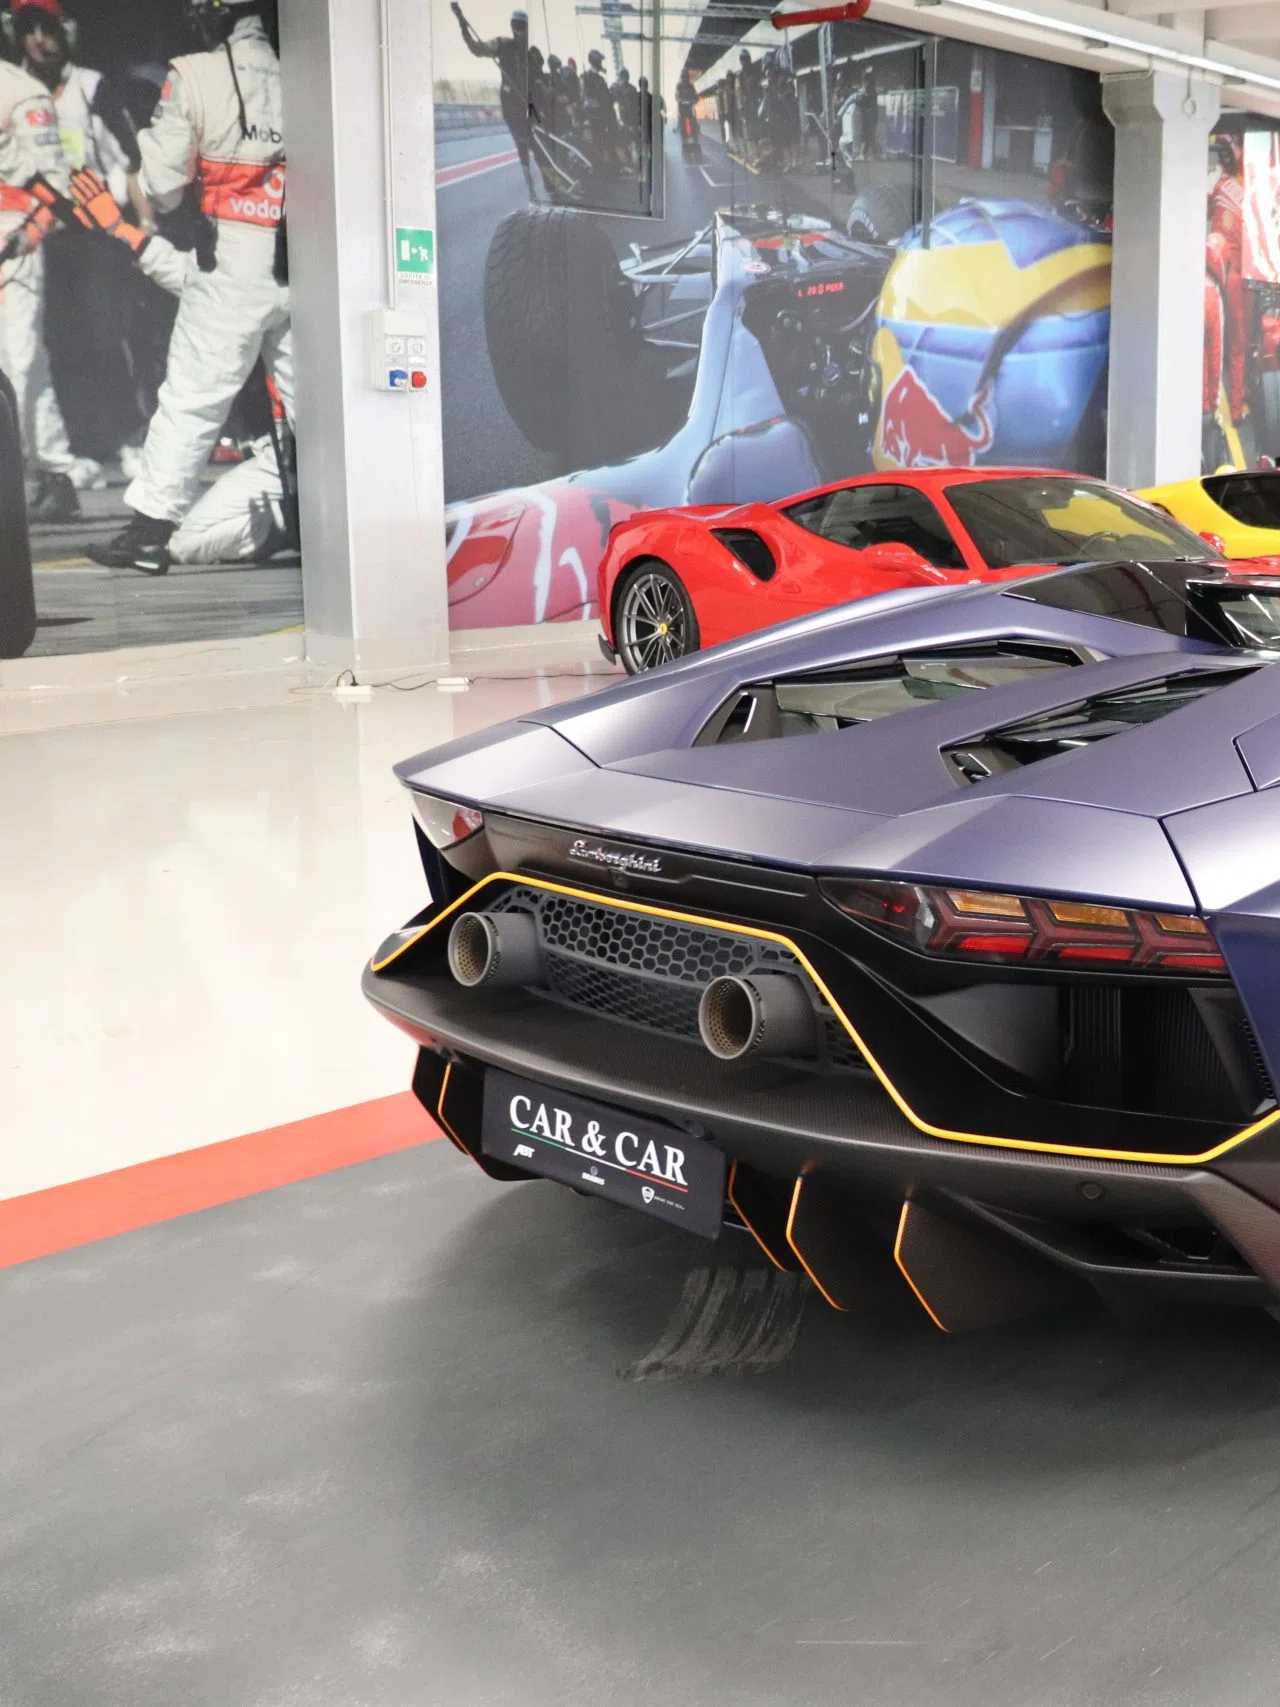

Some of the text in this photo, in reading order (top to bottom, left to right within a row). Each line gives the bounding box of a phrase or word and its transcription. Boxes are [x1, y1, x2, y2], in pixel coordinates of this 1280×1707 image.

[568, 839, 663, 873] Lamborghini
[509, 1095, 689, 1186] CAR & CAR
